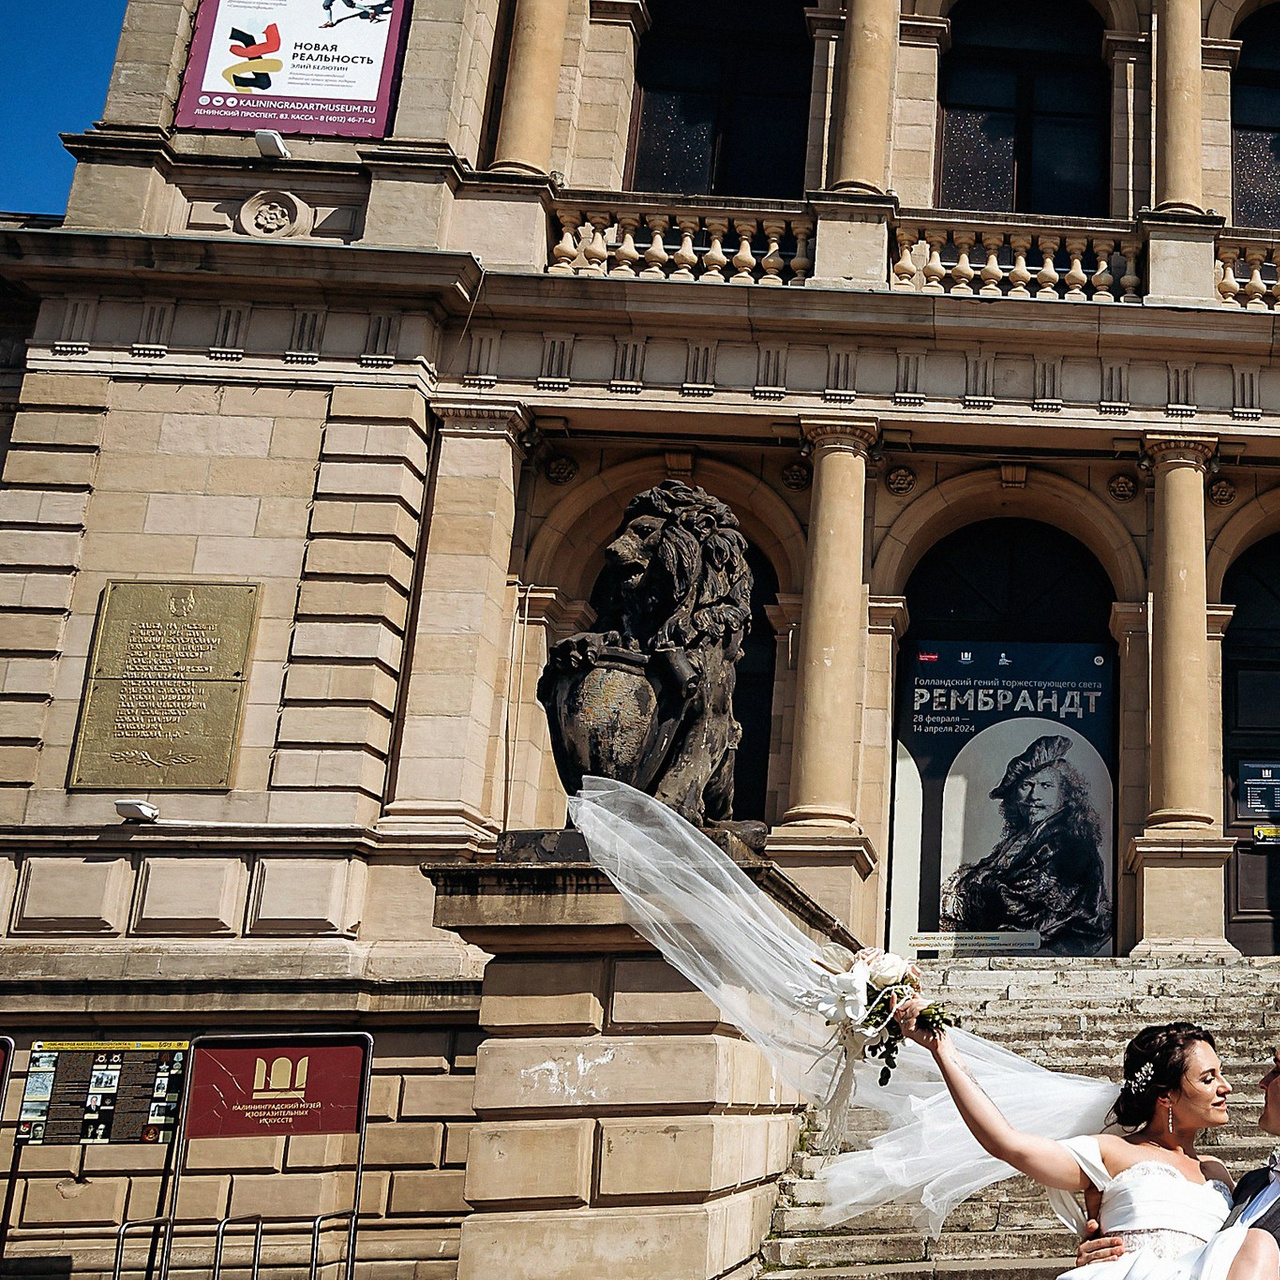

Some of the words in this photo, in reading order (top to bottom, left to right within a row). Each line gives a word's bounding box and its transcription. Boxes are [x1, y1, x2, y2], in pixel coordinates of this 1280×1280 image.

[293, 42, 338, 52] НОВАЯ
[291, 52, 374, 65] РЕАЛЬНОСТЬ
[239, 98, 376, 114] KALININGRADARTMUSEUM.RU
[194, 108, 240, 117] ЛЕНИНСКИЙ
[240, 111, 278, 120] ПРОСПЕКТ,
[325, 115, 346, 123] (4012)
[347, 116, 376, 124] 46-71-43
[914, 677, 972, 688] Голландский
[973, 678, 1000, 687] гений
[1001, 680, 1077, 689] торжествующего
[1078, 681, 1102, 689] света
[913, 688, 1102, 719] РЕМБРАНДТ
[913, 714, 924, 723] 28
[925, 714, 960, 724] февраля
[913, 724, 923, 732] 14
[924, 725, 953, 734] апреля
[954, 724, 975, 733] 2024
[232, 1102, 299, 1111] КАЛИНИНГРАДСКИЙ
[300, 1101, 321, 1109] МУЗЕЙ
[245, 1110, 309, 1118] ИЗОБРАЗИТЕЛЬНЫХ
